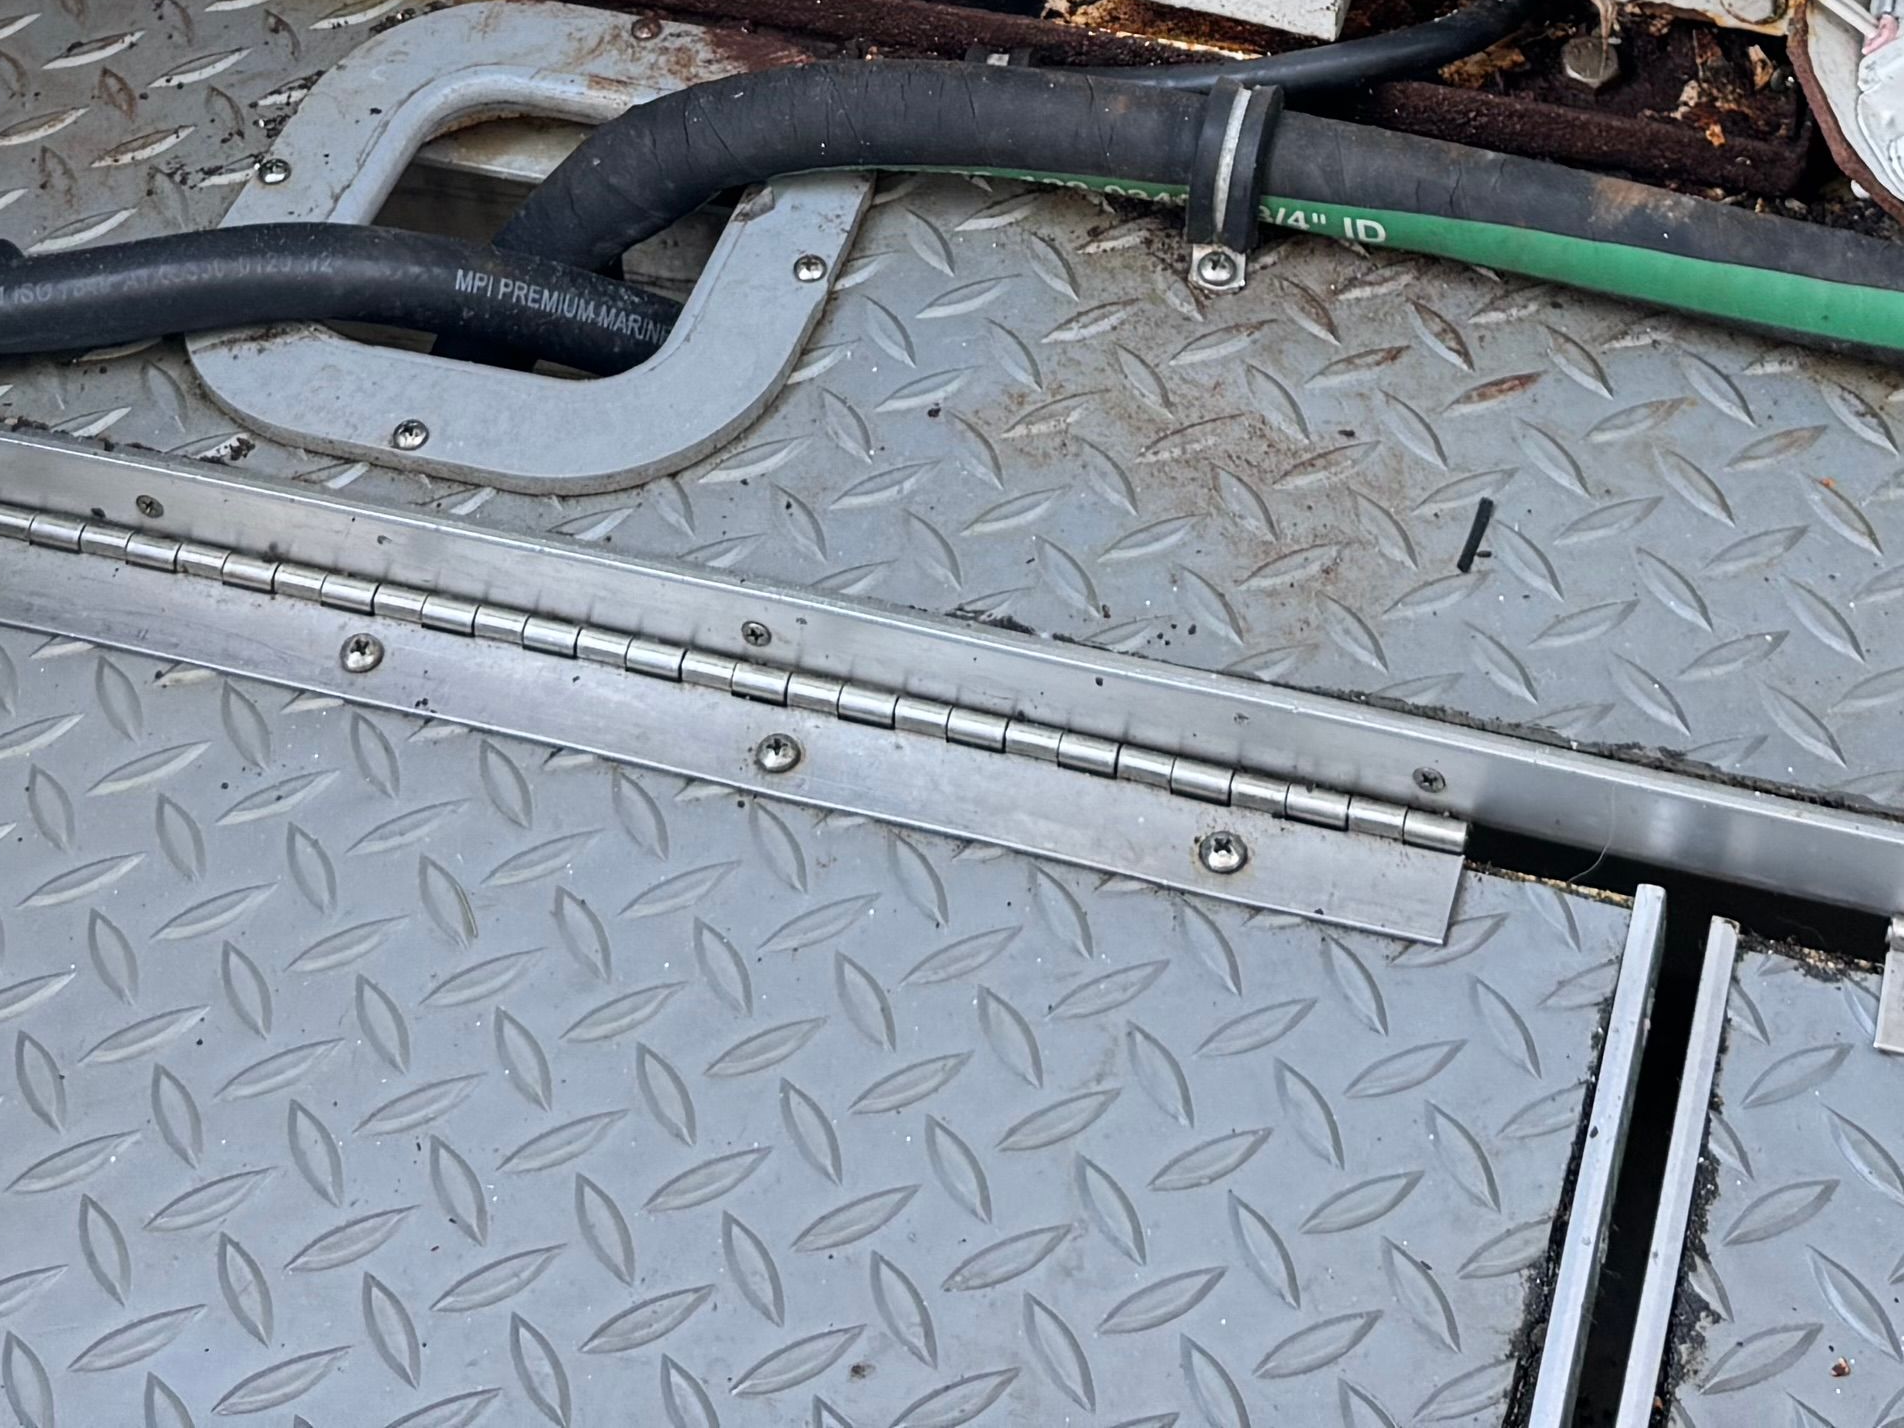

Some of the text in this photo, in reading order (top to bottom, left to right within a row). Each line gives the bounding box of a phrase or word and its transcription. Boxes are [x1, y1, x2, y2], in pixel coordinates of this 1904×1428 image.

[1343, 215, 1387, 243] ID
[455, 268, 595, 322] MPI PREMIUM
